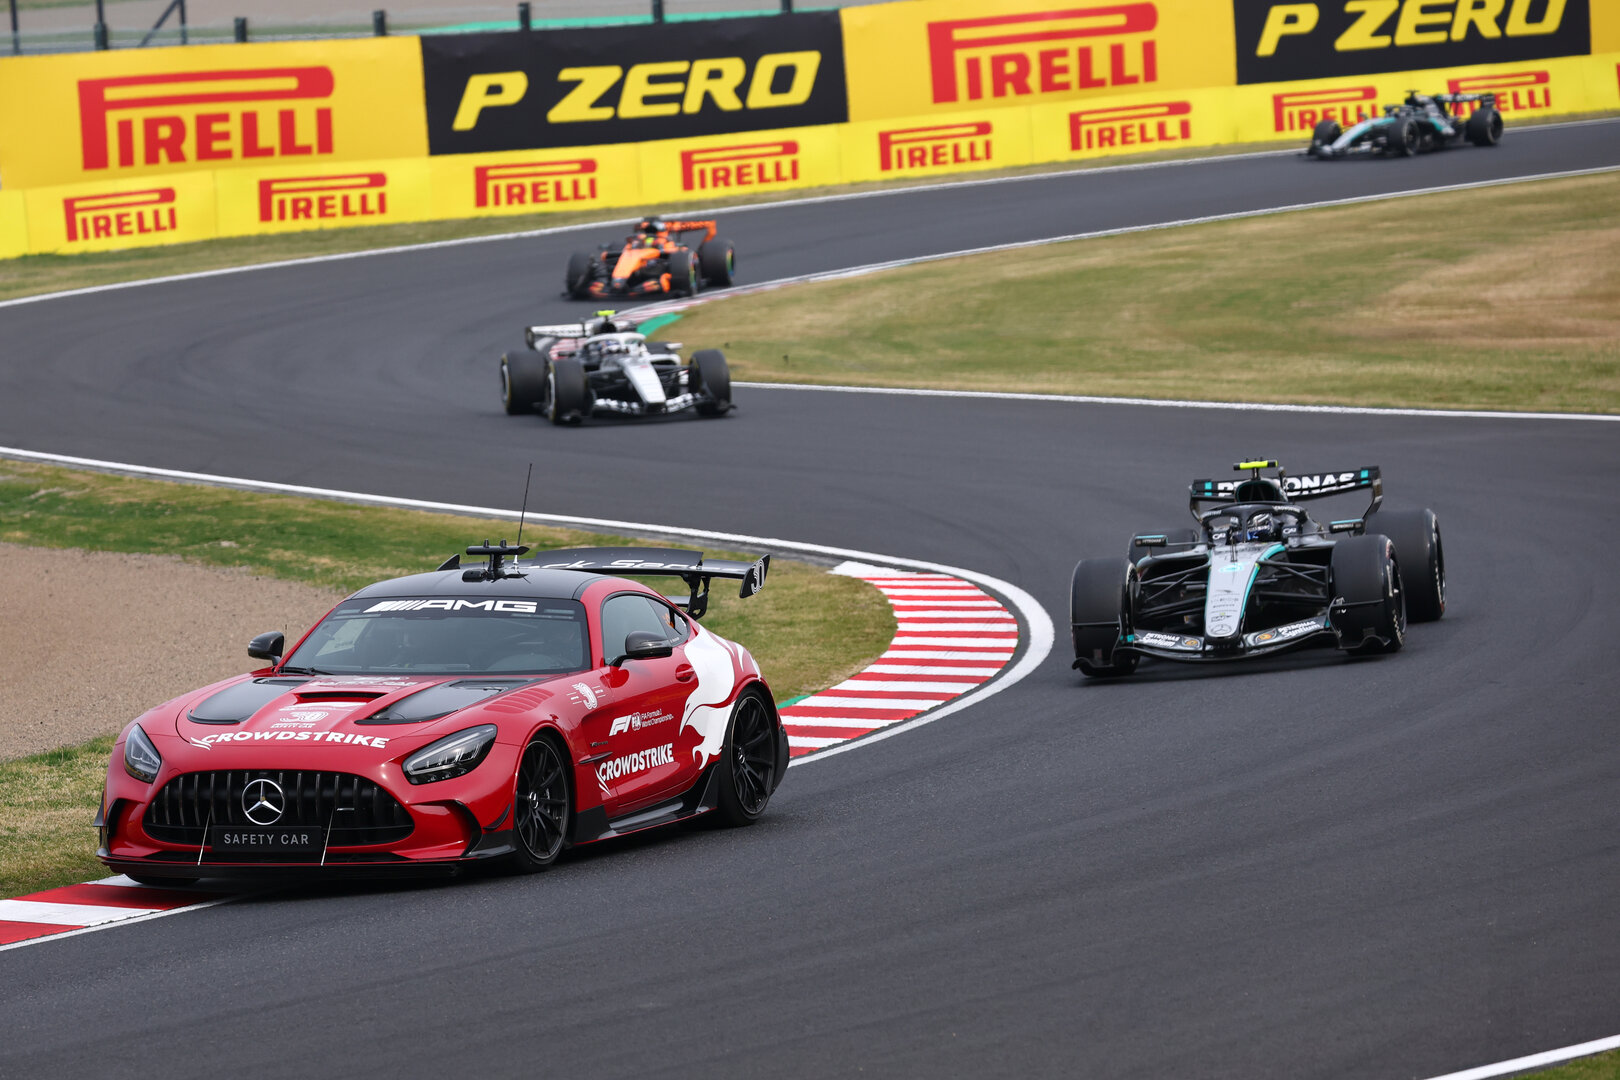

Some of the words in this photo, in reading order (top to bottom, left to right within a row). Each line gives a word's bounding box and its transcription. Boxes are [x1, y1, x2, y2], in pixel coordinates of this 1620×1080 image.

[927, 2, 1158, 104] PIRELLI
[1256, 3, 1319, 57] P
[1334, 0, 1567, 51] ZERO
[453, 71, 528, 131] P
[547, 51, 821, 123] ZERO
[77, 66, 335, 171] PIRELLI
[1069, 101, 1192, 151] PIRELLI
[680, 140, 799, 191] PIRELLI
[878, 121, 993, 171] PIRELLI
[259, 172, 387, 222] PIRELLI
[474, 159, 597, 208] PIRELLI
[63, 187, 177, 242] PIRELLI
[411, 600, 538, 613] AMG
[199, 731, 390, 749] CROWDSTRIKE
[597, 743, 675, 782] CROWDSTRIKE
[224, 833, 274, 845] SAFETY
[280, 833, 309, 845] CAR
